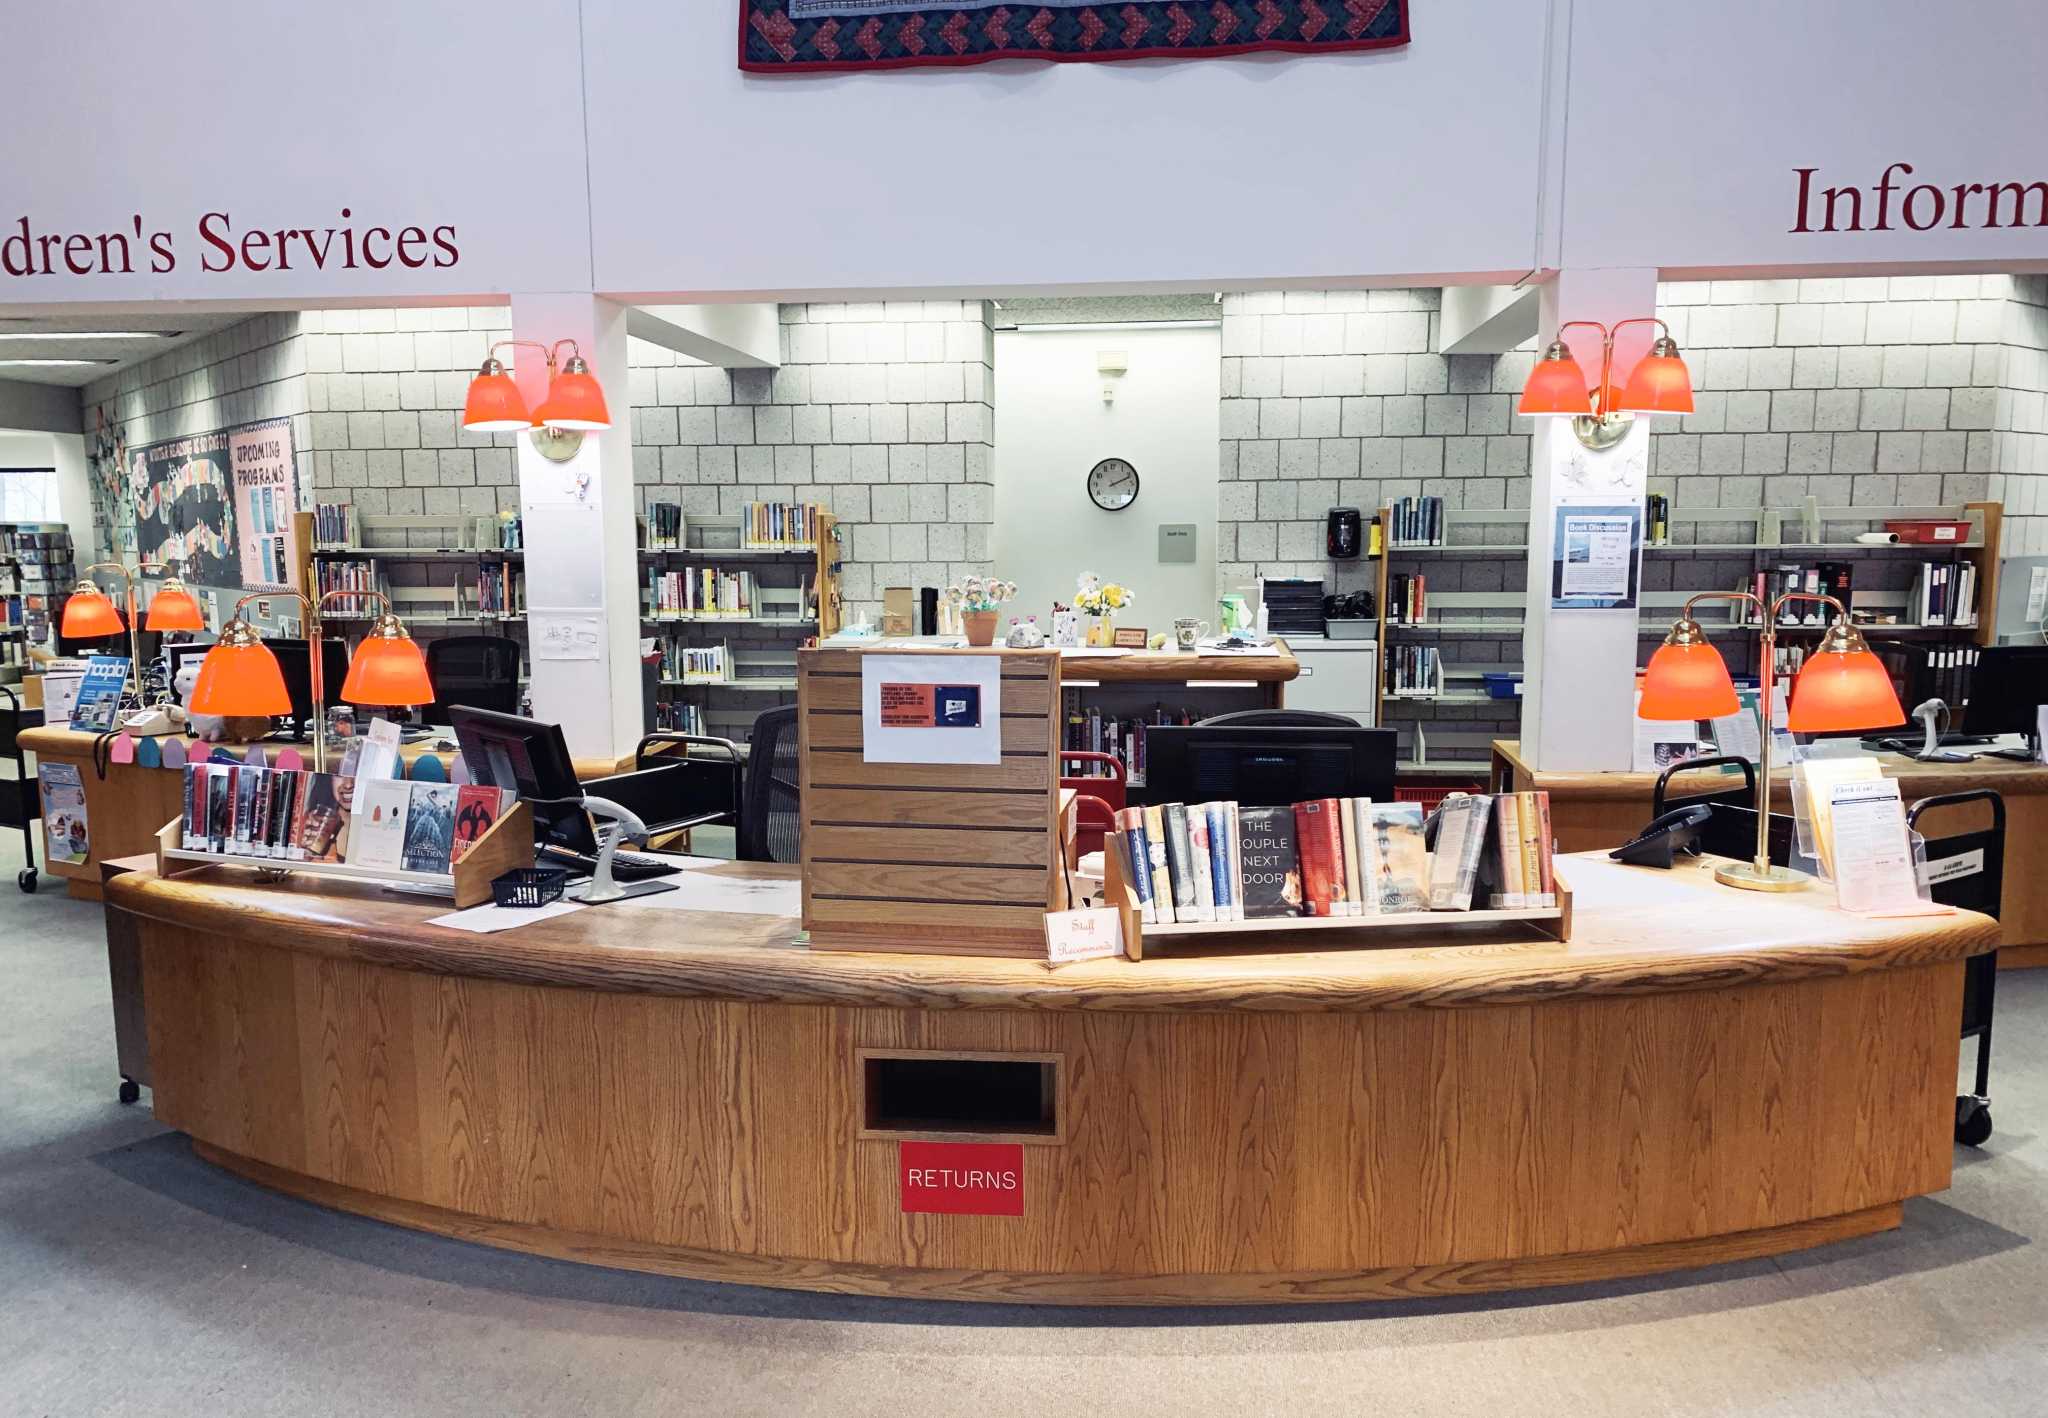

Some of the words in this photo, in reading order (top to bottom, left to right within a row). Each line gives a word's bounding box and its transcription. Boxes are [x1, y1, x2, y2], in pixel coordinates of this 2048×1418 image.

[198, 208, 460, 272] Services
[237, 440, 281, 463] UPCOMING
[237, 464, 285, 486] PROGRAMS
[88, 658, 126, 680] hoopla
[1245, 821, 1272, 832] THE
[1243, 855, 1280, 866] NEXT
[1243, 873, 1284, 884] DOOR
[909, 1169, 1016, 1189] RETURNS
